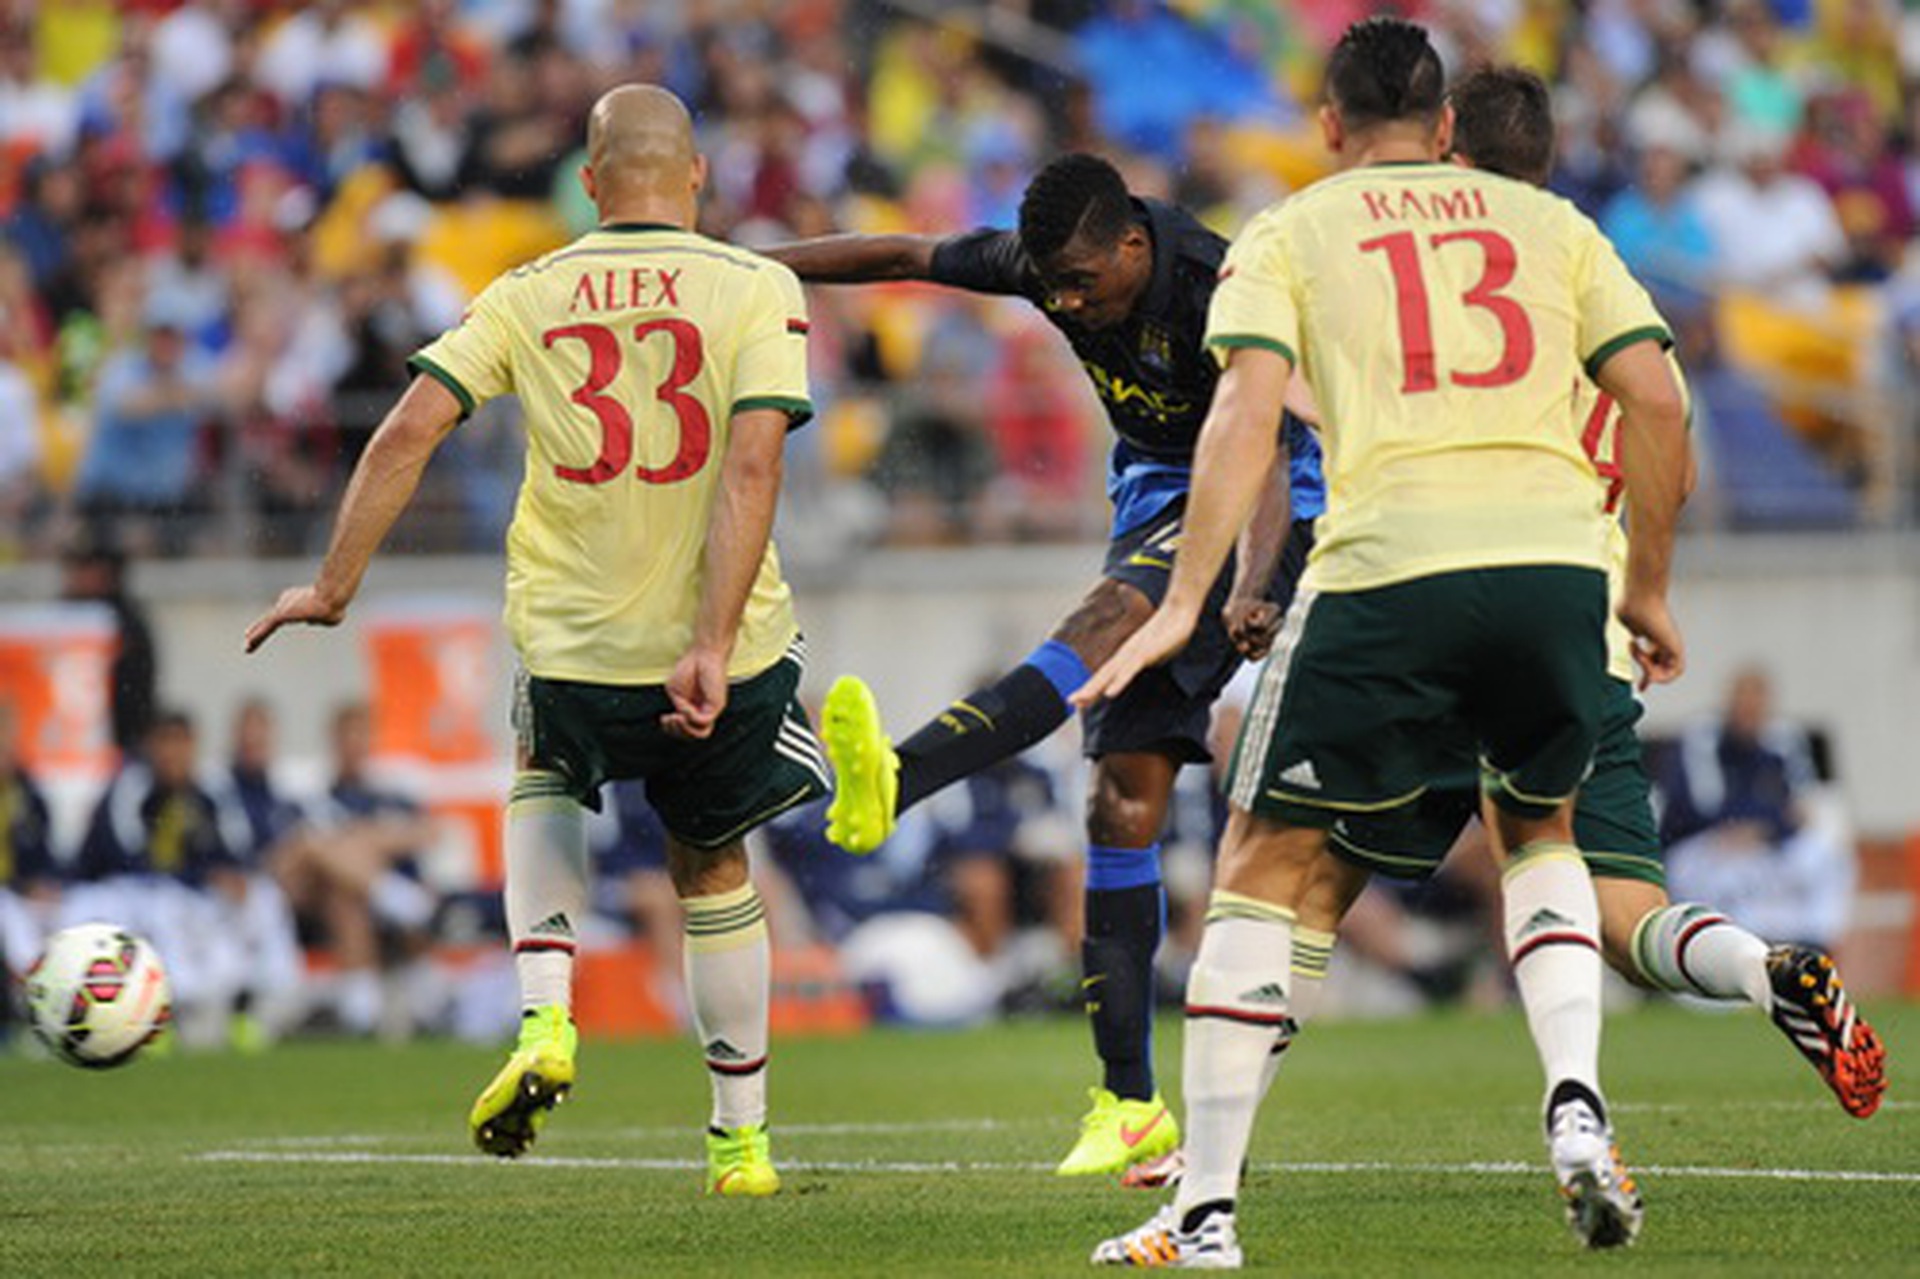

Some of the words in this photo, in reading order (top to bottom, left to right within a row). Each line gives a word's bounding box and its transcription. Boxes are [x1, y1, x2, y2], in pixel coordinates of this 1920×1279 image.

[1361, 187, 1489, 221] RAMI
[570, 267, 683, 313] ALEX
[1357, 228, 1536, 396] 13
[542, 317, 712, 485] 33
